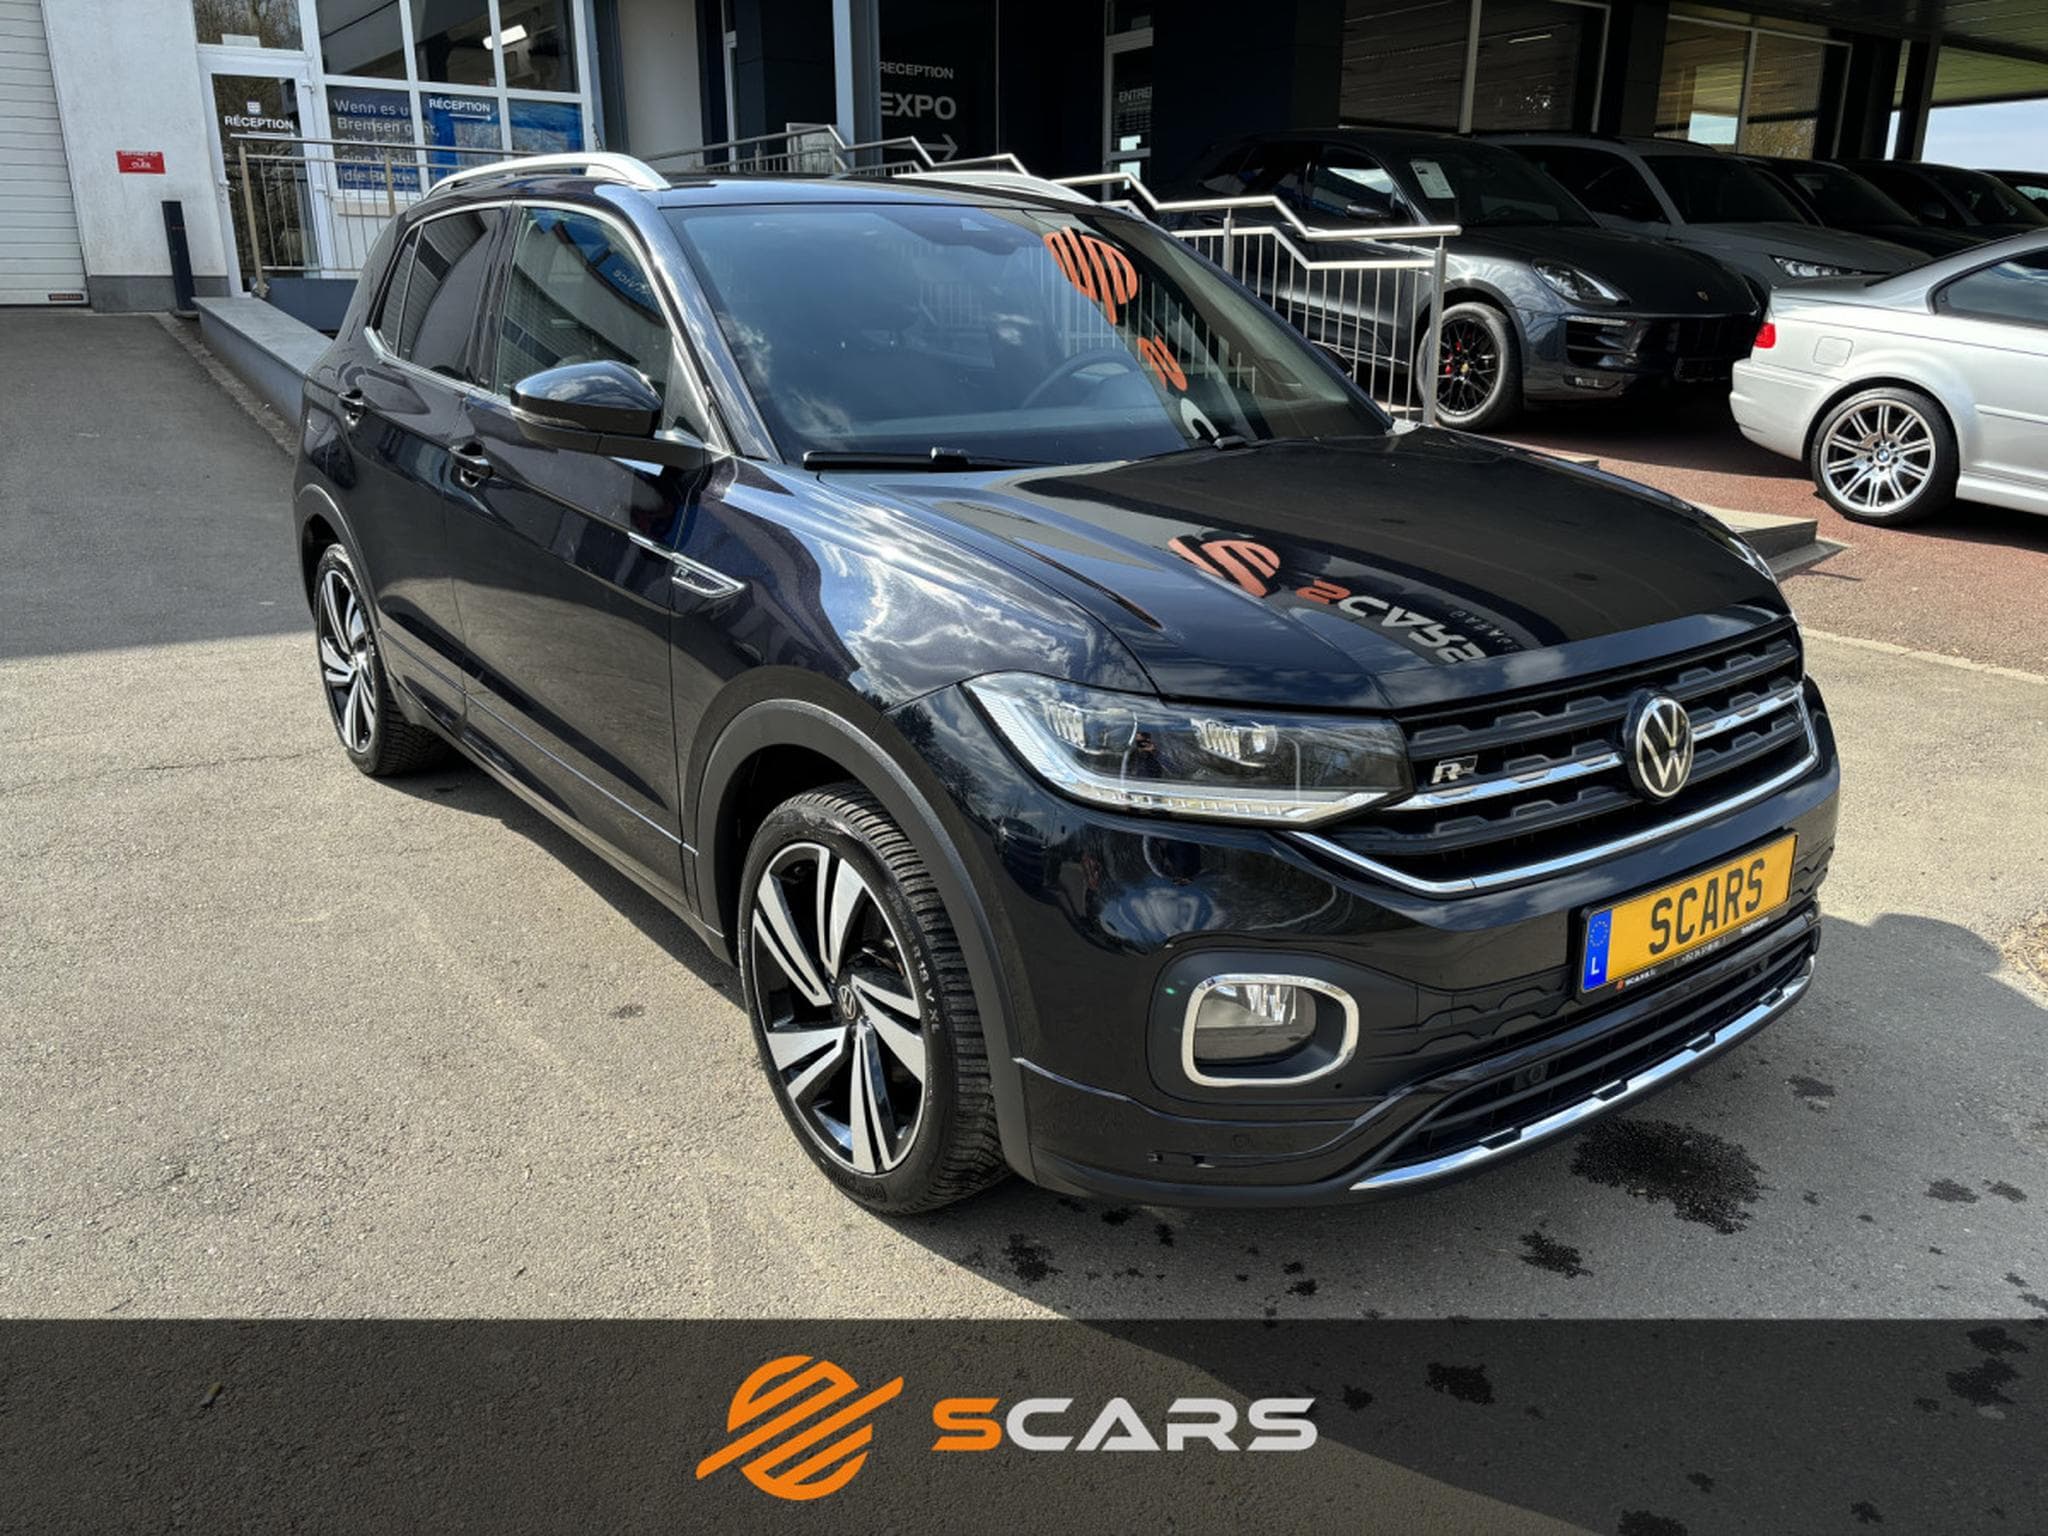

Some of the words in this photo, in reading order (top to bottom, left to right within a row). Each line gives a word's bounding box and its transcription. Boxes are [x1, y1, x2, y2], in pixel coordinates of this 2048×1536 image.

[333, 99, 376, 115] Wenn
[380, 104, 395, 116] es
[429, 98, 491, 113] RÉCEPTION
[880, 91, 956, 120] EXPO
[224, 113, 294, 130] RÉCEPTION
[337, 117, 400, 134] Bremsen
[1648, 857, 1766, 956] SCARS
[1590, 956, 1600, 976] L
